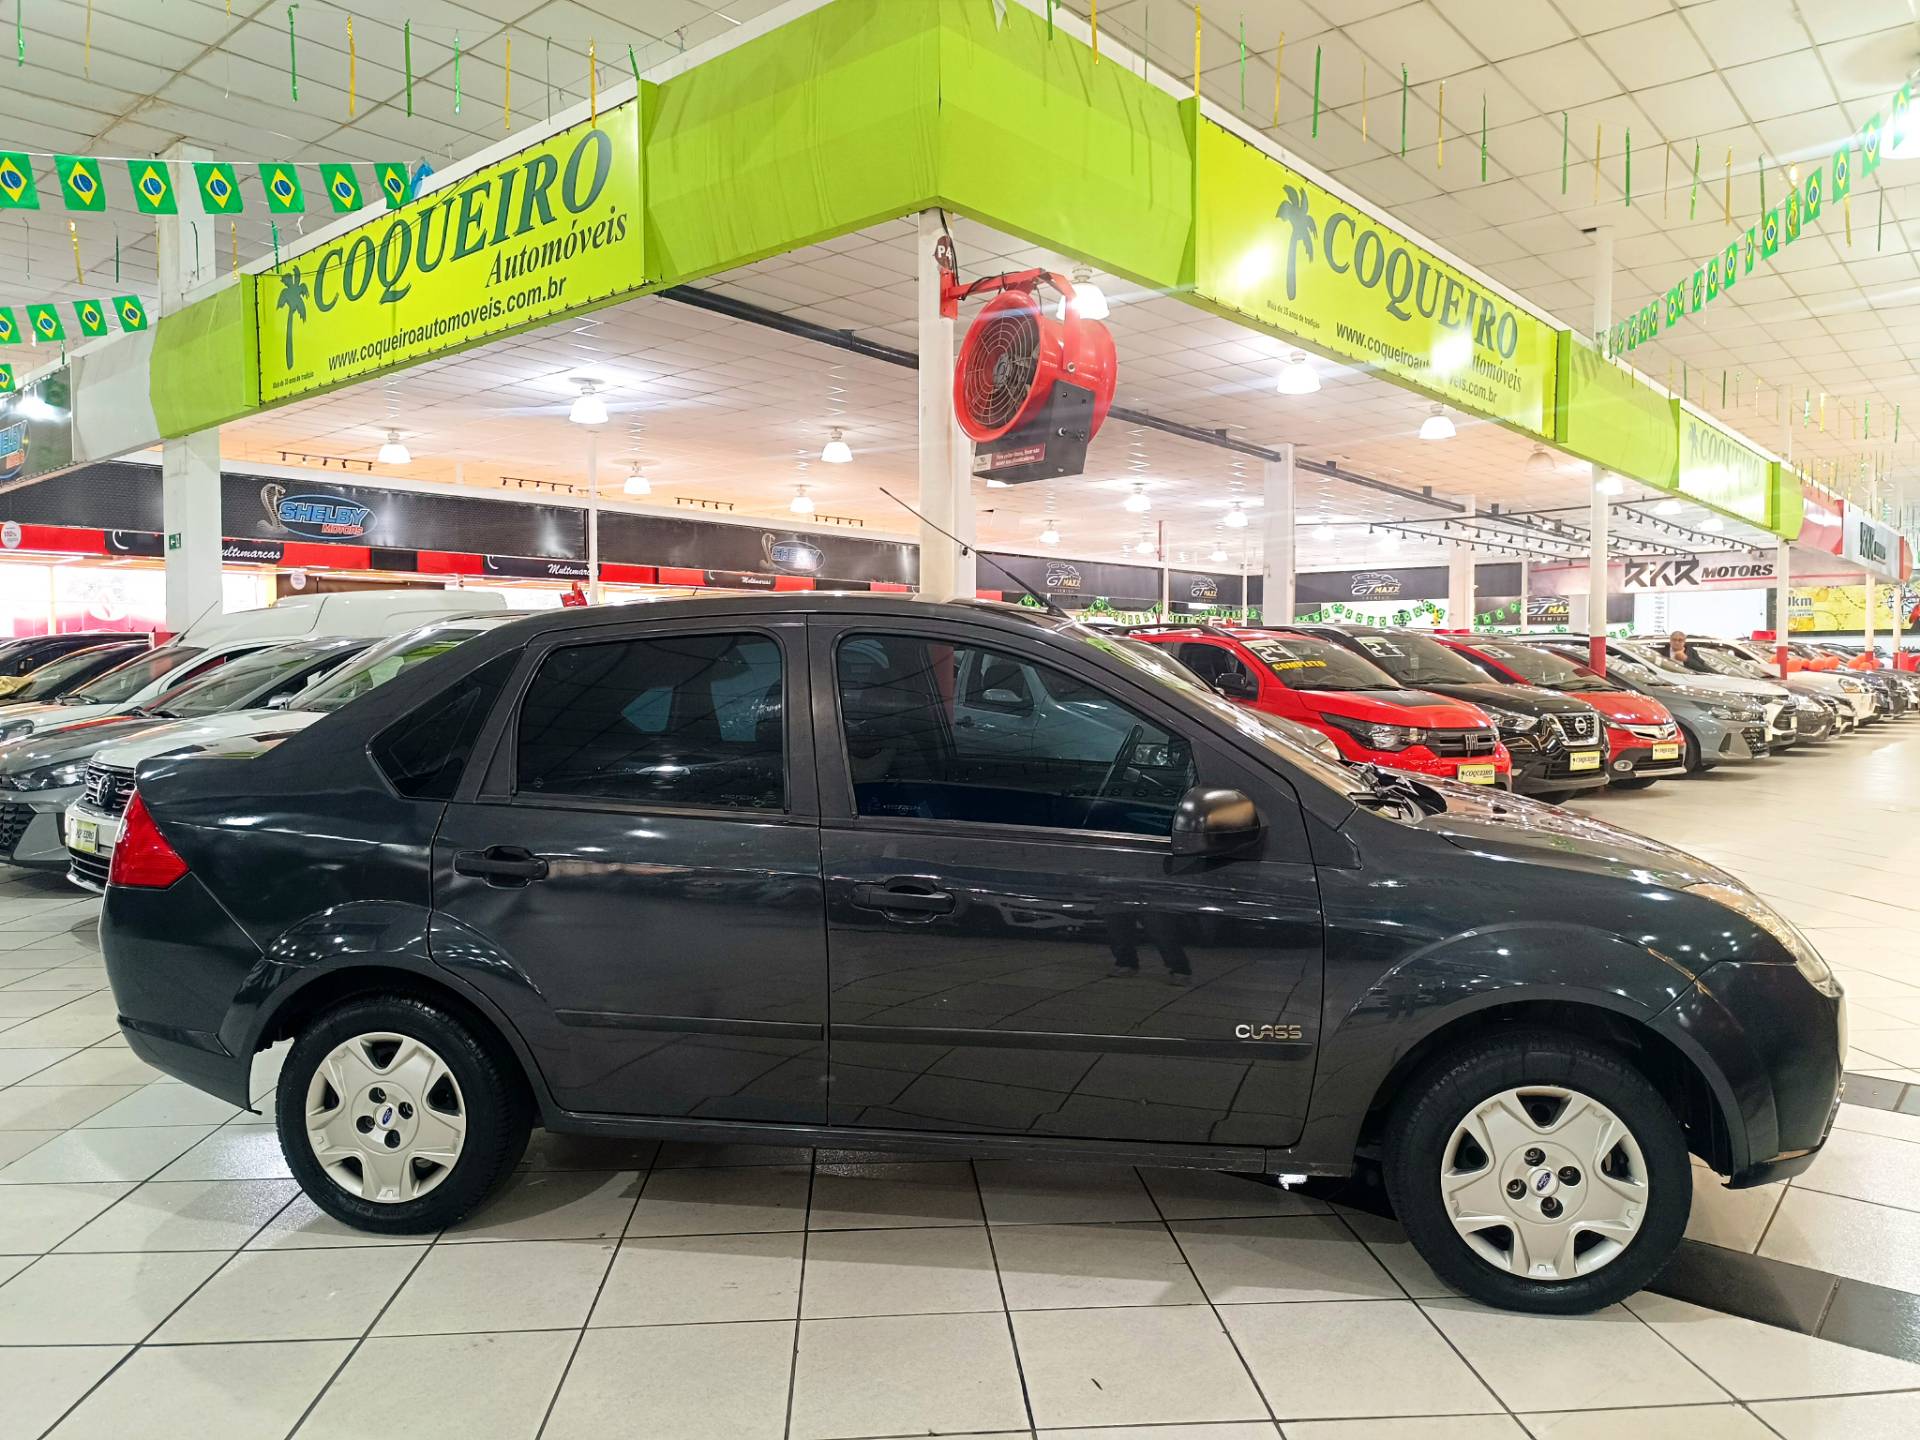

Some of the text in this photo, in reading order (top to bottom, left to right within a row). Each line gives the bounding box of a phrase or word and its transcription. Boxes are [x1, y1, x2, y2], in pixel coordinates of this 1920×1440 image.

[313, 129, 612, 312] COQUEIRO
[486, 205, 628, 288] Automóveis
[937, 245, 953, 260] P4
[1323, 212, 1518, 359] COQUEIRO
[328, 273, 567, 372] www.coqueiroautomoveis.com.br
[280, 502, 370, 526] SHELBY
[321, 523, 364, 535] MOTORS
[221, 545, 282, 561] ultimarcas
[1701, 563, 1774, 578] MOTORS
[1272, 660, 1328, 672] COMPLETO
[1465, 734, 1479, 751] FIAT
[1235, 1024, 1303, 1040] CLASS
